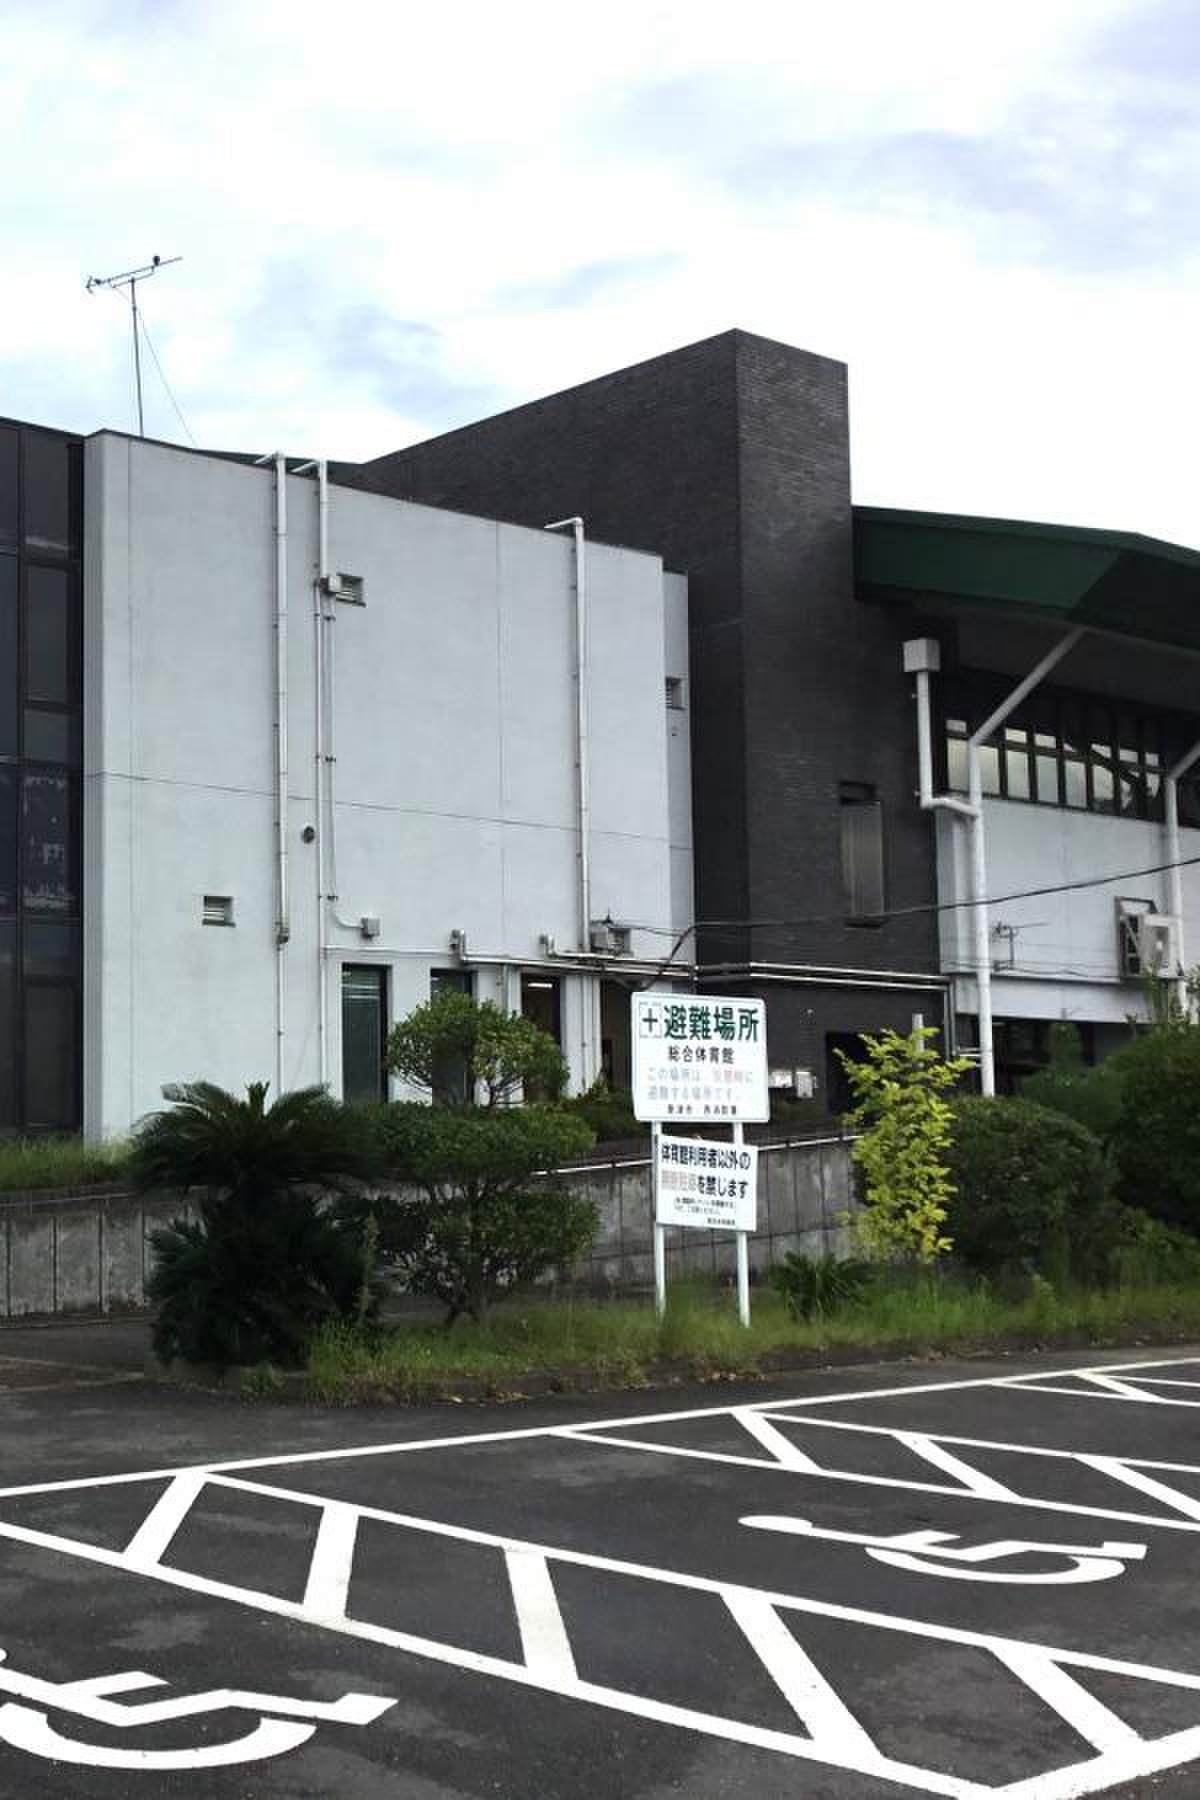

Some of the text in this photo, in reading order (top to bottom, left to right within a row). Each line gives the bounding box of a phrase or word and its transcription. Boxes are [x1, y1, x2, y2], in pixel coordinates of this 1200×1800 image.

[663, 1005, 759, 1042] 避難場所
[667, 1045, 735, 1064] 総合体育館
[661, 1142, 751, 1170] 体育館利用者以外の
